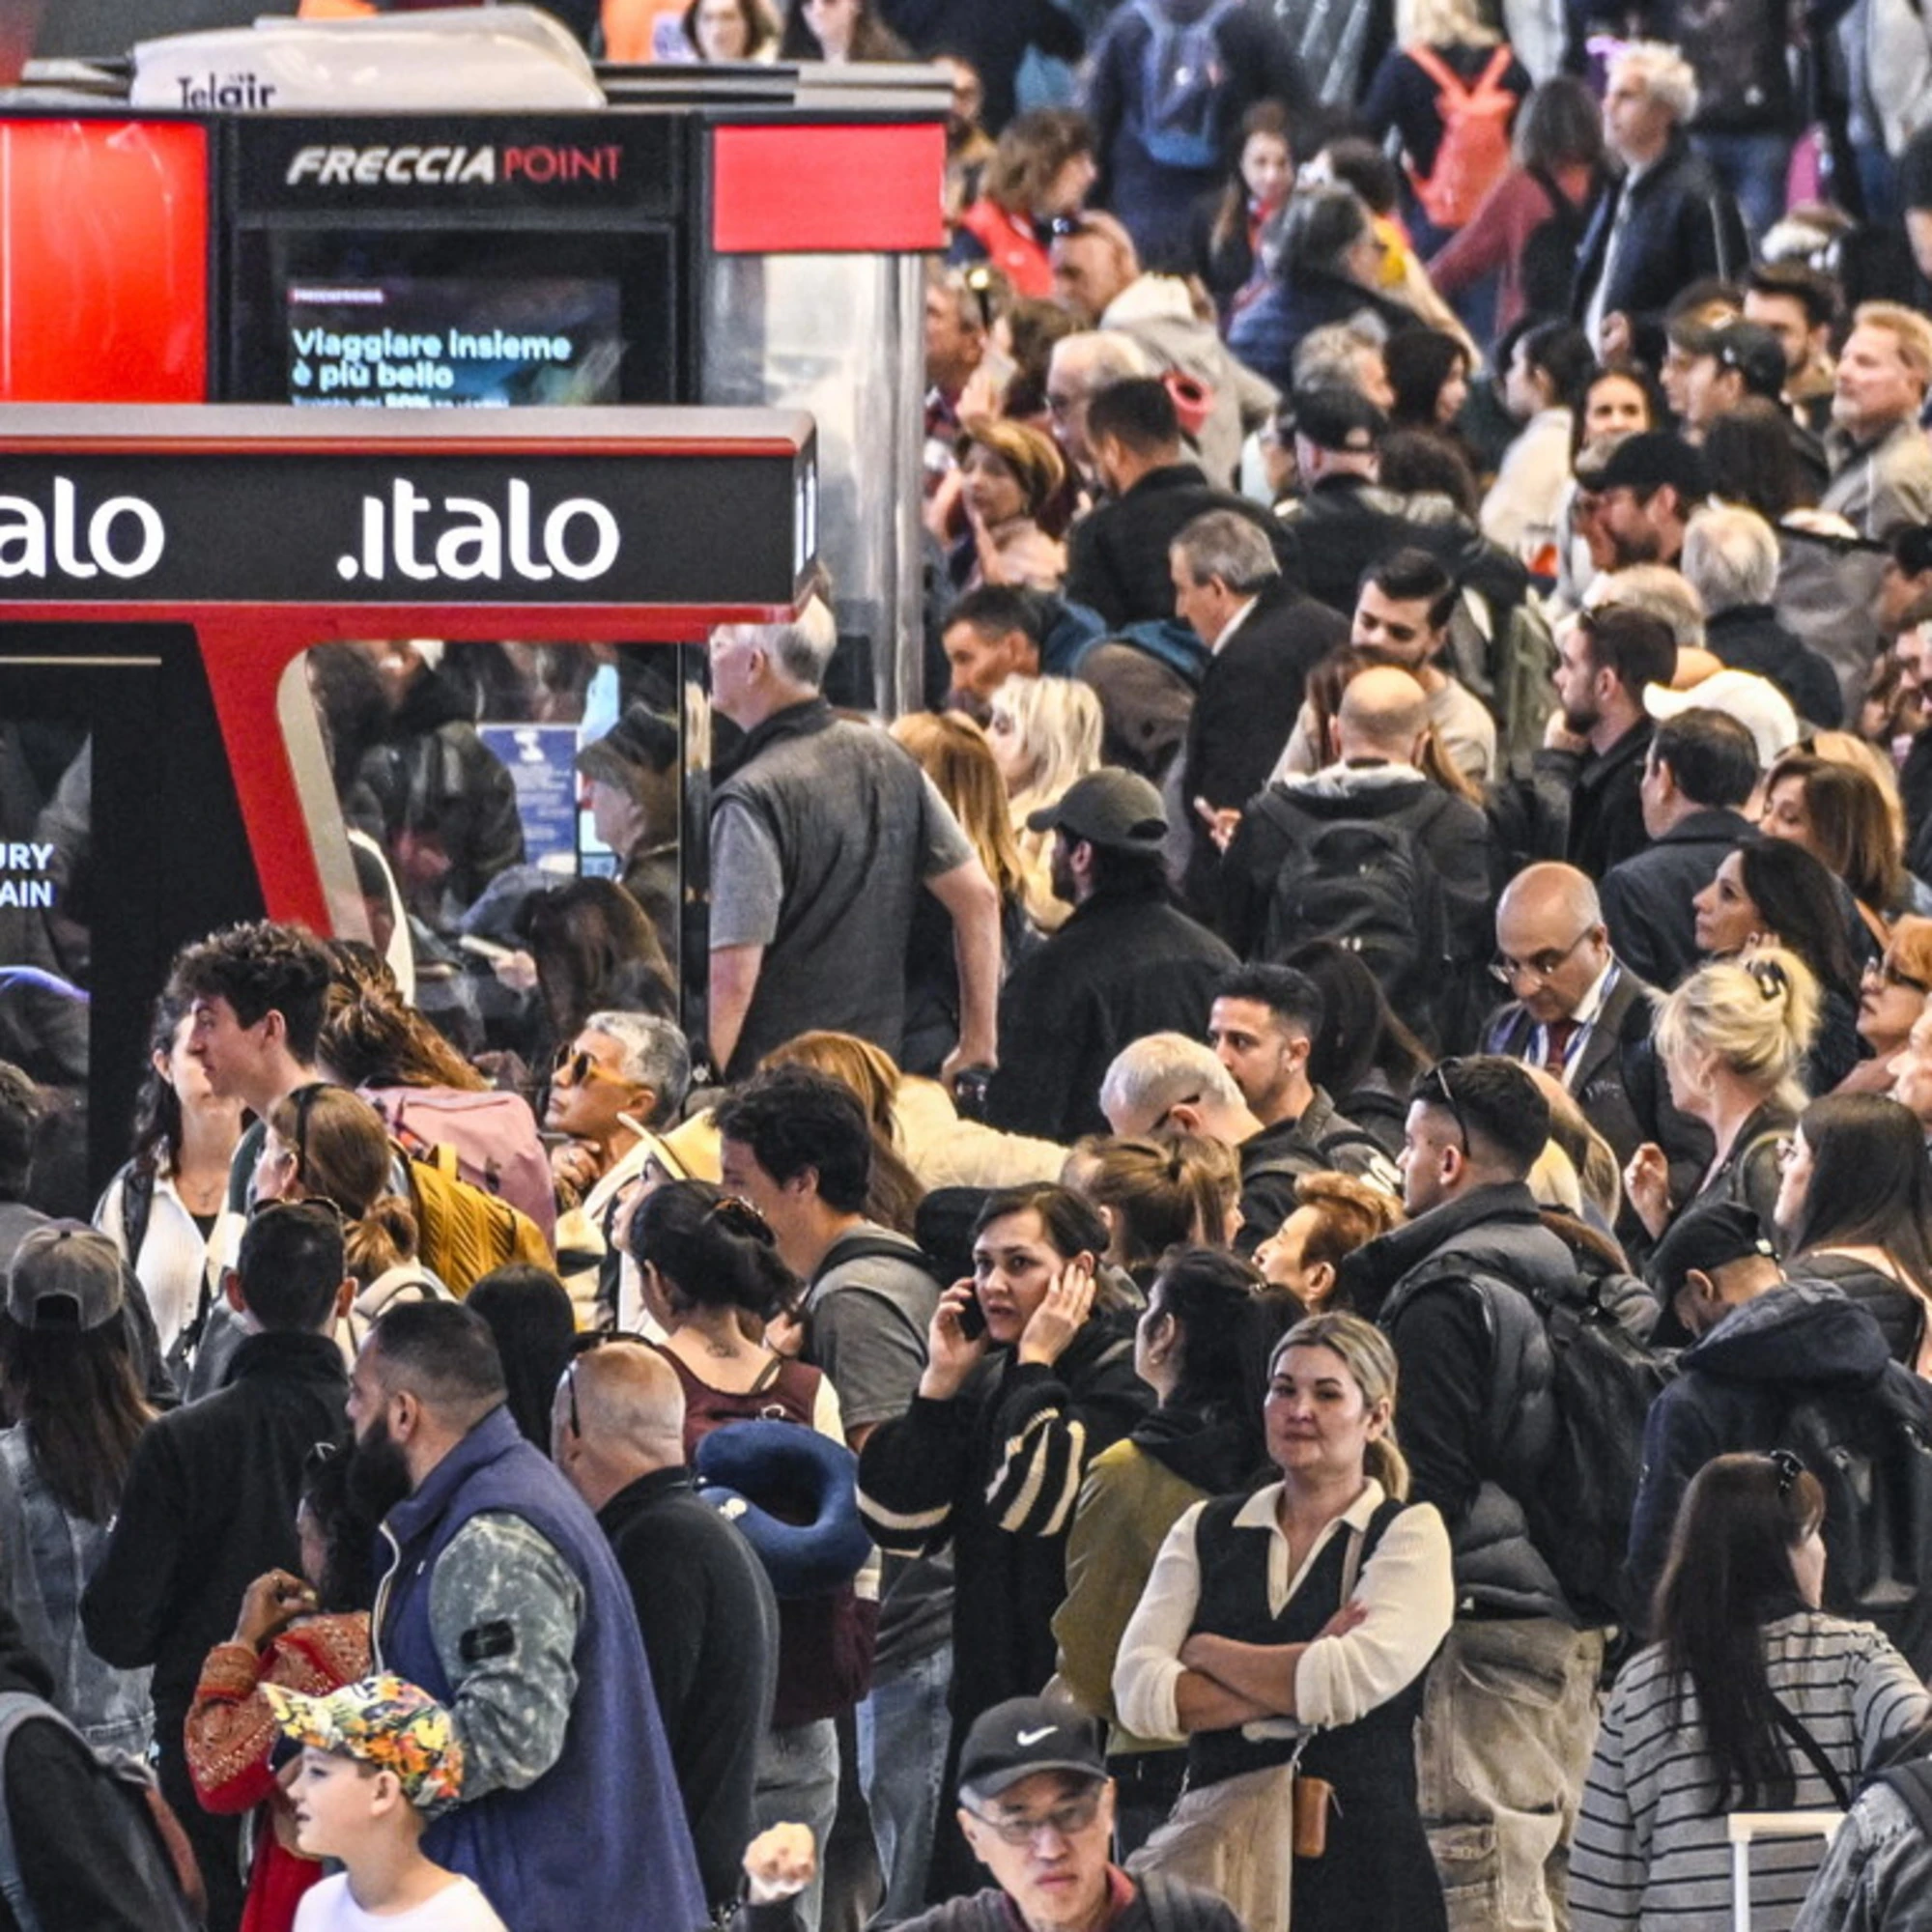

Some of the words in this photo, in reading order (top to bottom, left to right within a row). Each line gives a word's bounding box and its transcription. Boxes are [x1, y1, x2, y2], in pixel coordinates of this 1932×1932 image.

[286, 145, 496, 185] FRECCIA
[503, 146, 621, 182] POINT
[292, 327, 443, 363] Viaggiare
[449, 327, 572, 360] insieme
[319, 358, 371, 392] più
[377, 358, 455, 389] bello
[0, 842, 54, 870] RY
